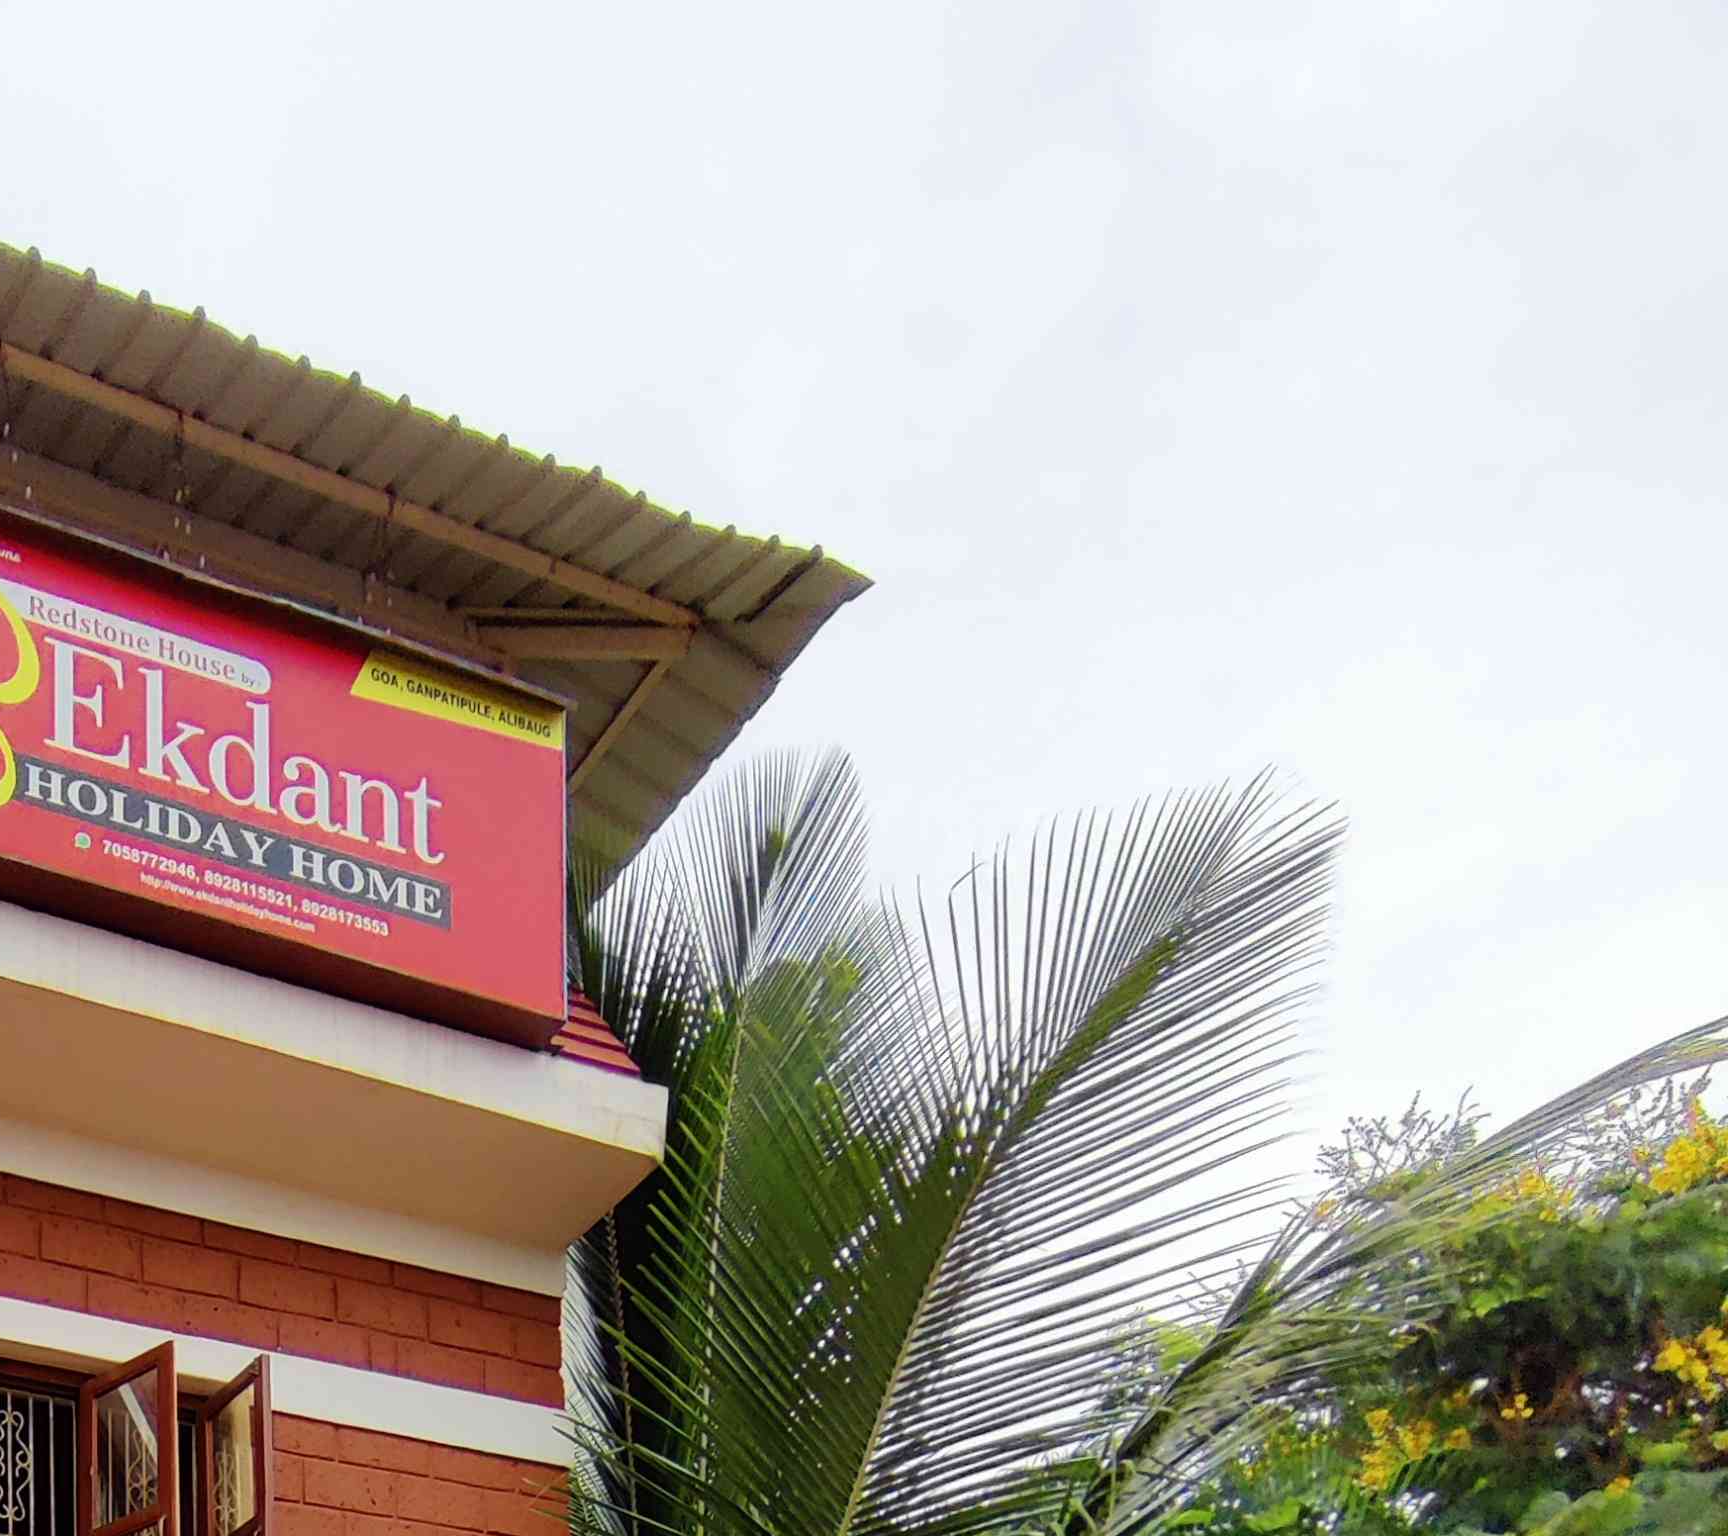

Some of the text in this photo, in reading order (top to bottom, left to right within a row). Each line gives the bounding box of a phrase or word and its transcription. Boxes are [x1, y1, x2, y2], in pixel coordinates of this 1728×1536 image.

[29, 595, 151, 653] Redstone
[158, 637, 236, 681] House
[43, 636, 445, 864] Ekdant
[406, 679, 496, 721] GANPATIPULE,
[498, 711, 551, 738] ALIBAUG
[24, 762, 443, 919] HOLIDAY HOME
